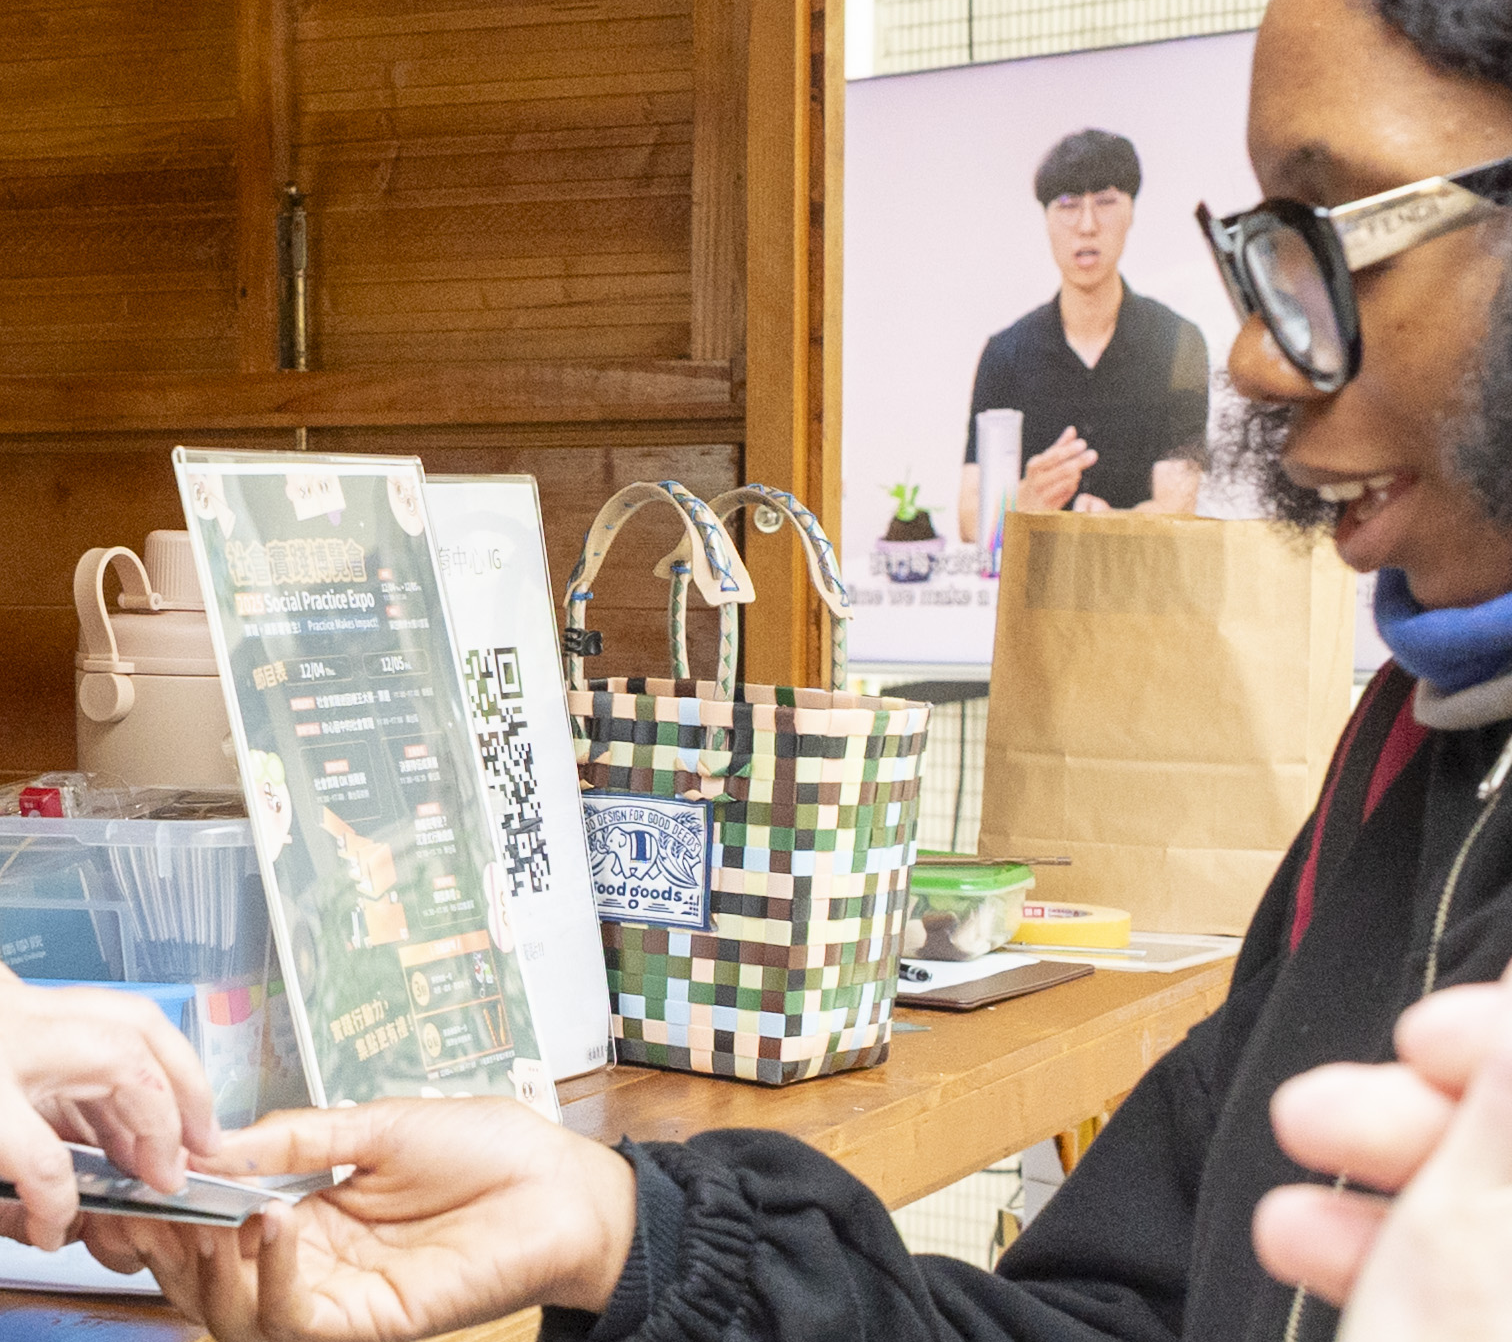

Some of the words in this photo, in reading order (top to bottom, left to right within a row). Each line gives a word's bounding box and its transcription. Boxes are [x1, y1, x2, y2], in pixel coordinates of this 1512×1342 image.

[226, 538, 367, 587] 社會實踐博覽會
[237, 594, 265, 616] 2025
[264, 589, 303, 613] Social
[302, 588, 348, 611] Practice
[347, 588, 376, 612] Expo
[300, 662, 325, 681] 12/04
[381, 656, 405, 673] 12/05
[597, 810, 627, 826] DESIGN
[629, 809, 645, 821] FOR
[648, 812, 671, 830] GOOD
[672, 824, 700, 852] DEEDS
[594, 881, 627, 896] ood
[628, 885, 683, 909] goods
